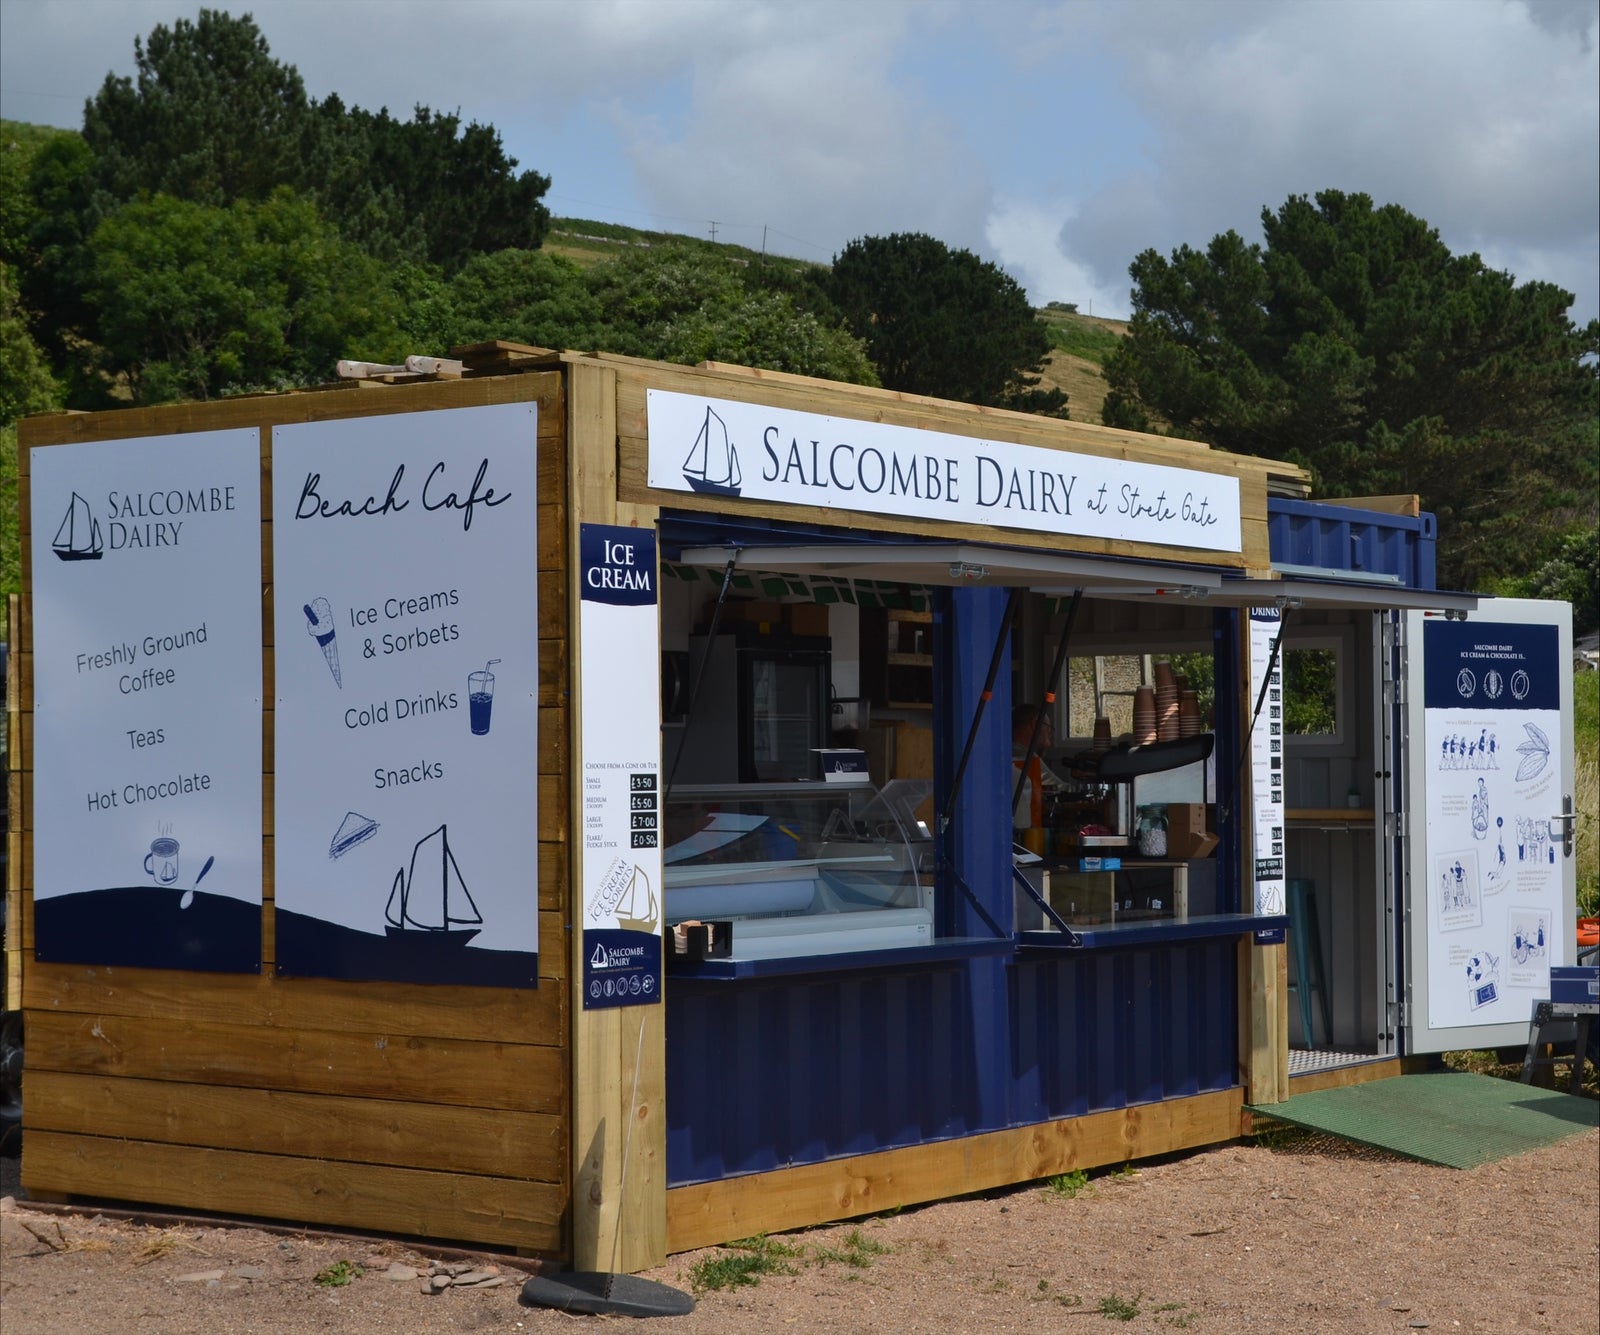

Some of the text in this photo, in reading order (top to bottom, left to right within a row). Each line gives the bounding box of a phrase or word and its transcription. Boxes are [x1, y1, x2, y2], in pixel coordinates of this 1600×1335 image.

[761, 426, 1218, 527] SALCOMBE DAIRY at Strete Gate
[108, 487, 235, 520] SALCOMBE
[295, 458, 512, 531] Beach Cafe
[109, 522, 183, 550] DAIRY
[603, 540, 634, 566] ICE
[587, 567, 651, 591] CREAM
[350, 590, 459, 628] Ice Creams
[77, 622, 208, 674] Freshly Ground
[362, 622, 460, 659] & Sorbets
[119, 667, 176, 695] Coffee
[344, 690, 458, 729] Cold Drinks
[126, 728, 165, 750] Teas
[374, 760, 443, 789] Snacks
[632, 777, 652, 789] £3.50
[87, 773, 211, 812] Hot Chocolate
[632, 797, 652, 809] £5.50
[590, 860, 627, 922] ICE CREAM
[604, 866, 633, 916] & SORBETS
[609, 947, 644, 957] SALCOMBE
[609, 957, 630, 967] DAIRY
